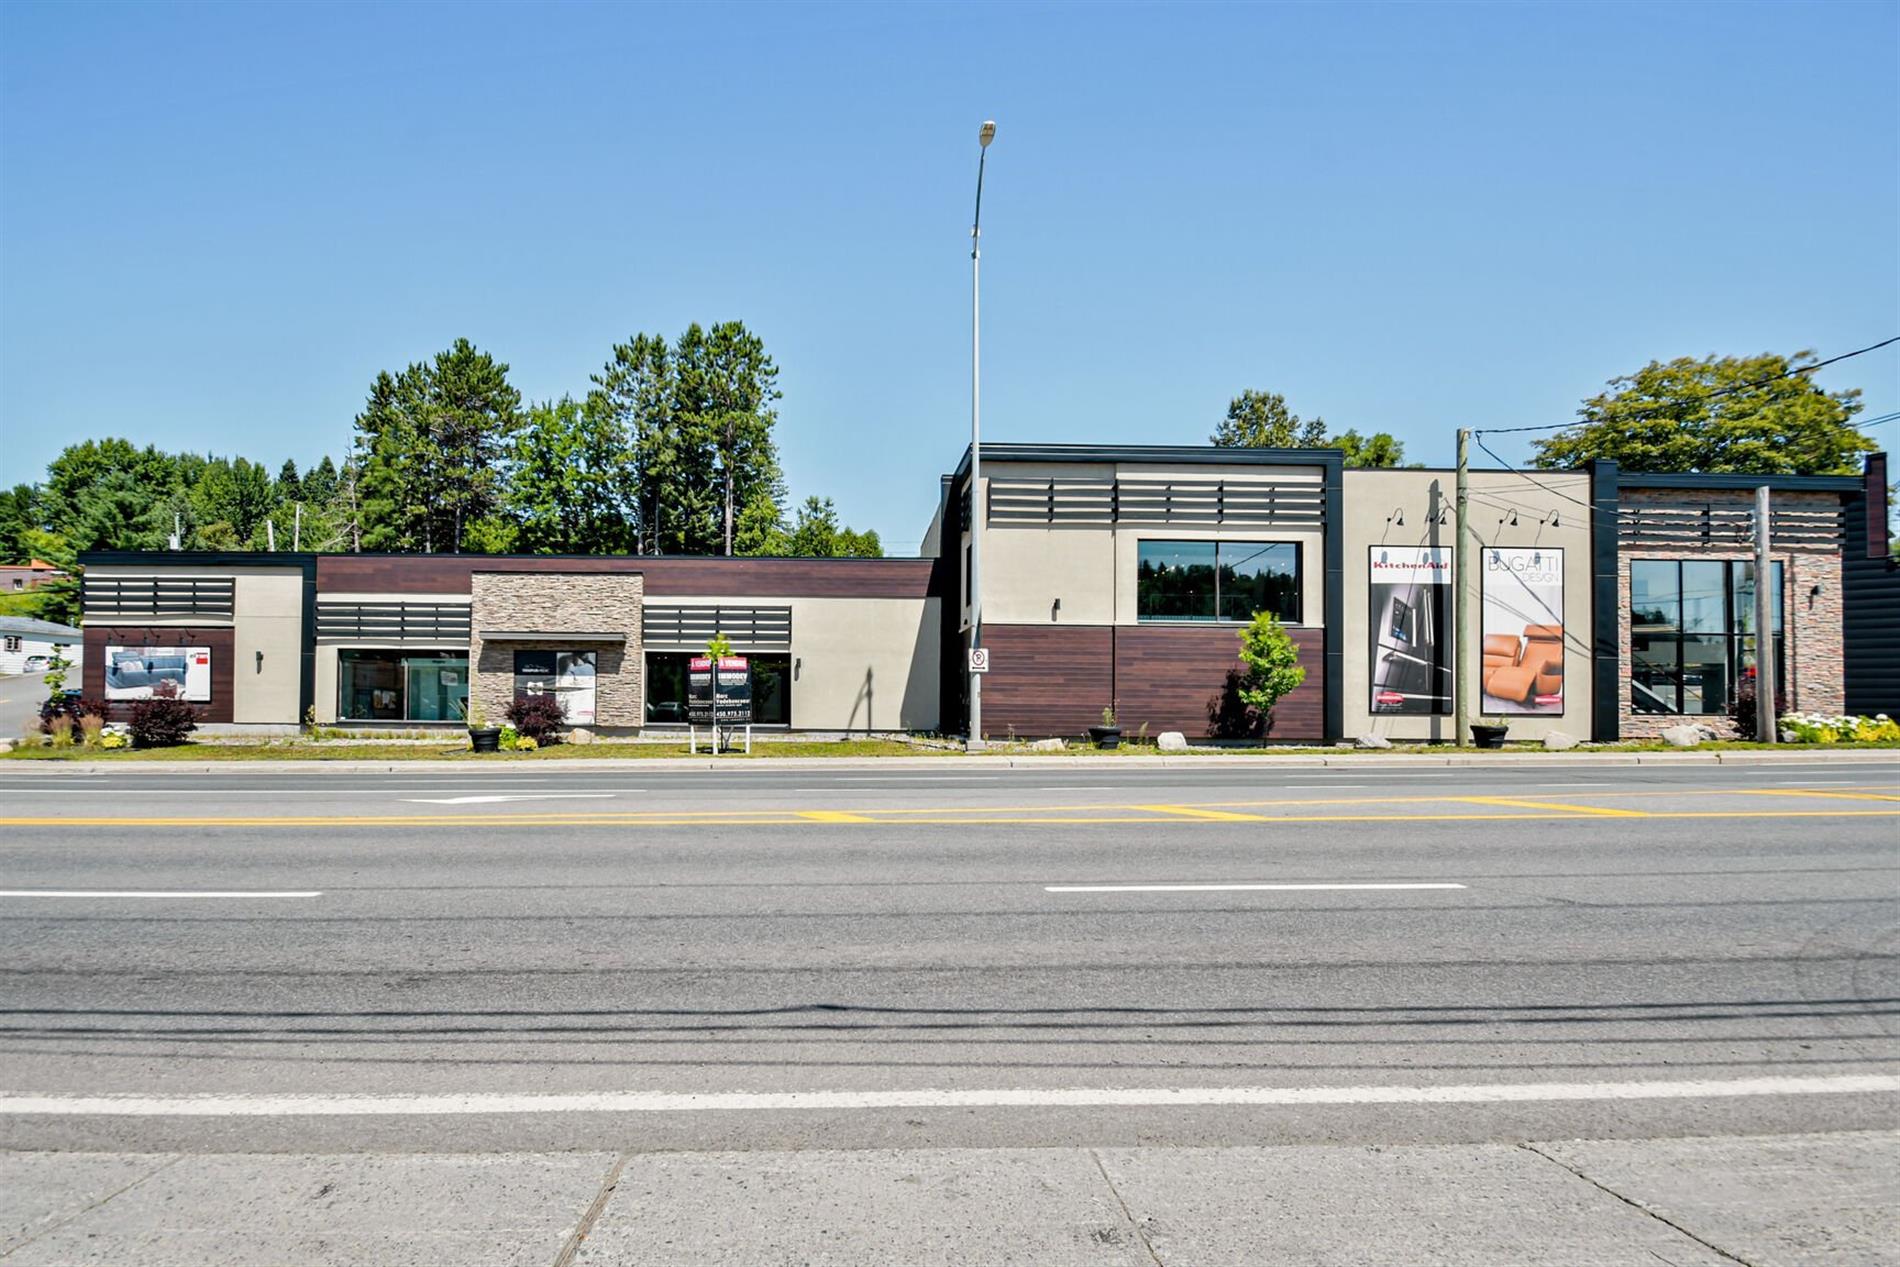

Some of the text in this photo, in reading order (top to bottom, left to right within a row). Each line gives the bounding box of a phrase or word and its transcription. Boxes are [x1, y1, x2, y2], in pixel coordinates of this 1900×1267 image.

[1373, 561, 1449, 570] KitchenAid
[1488, 556, 1559, 572] BUGATTI
[1522, 572, 1559, 583] DESIGN
